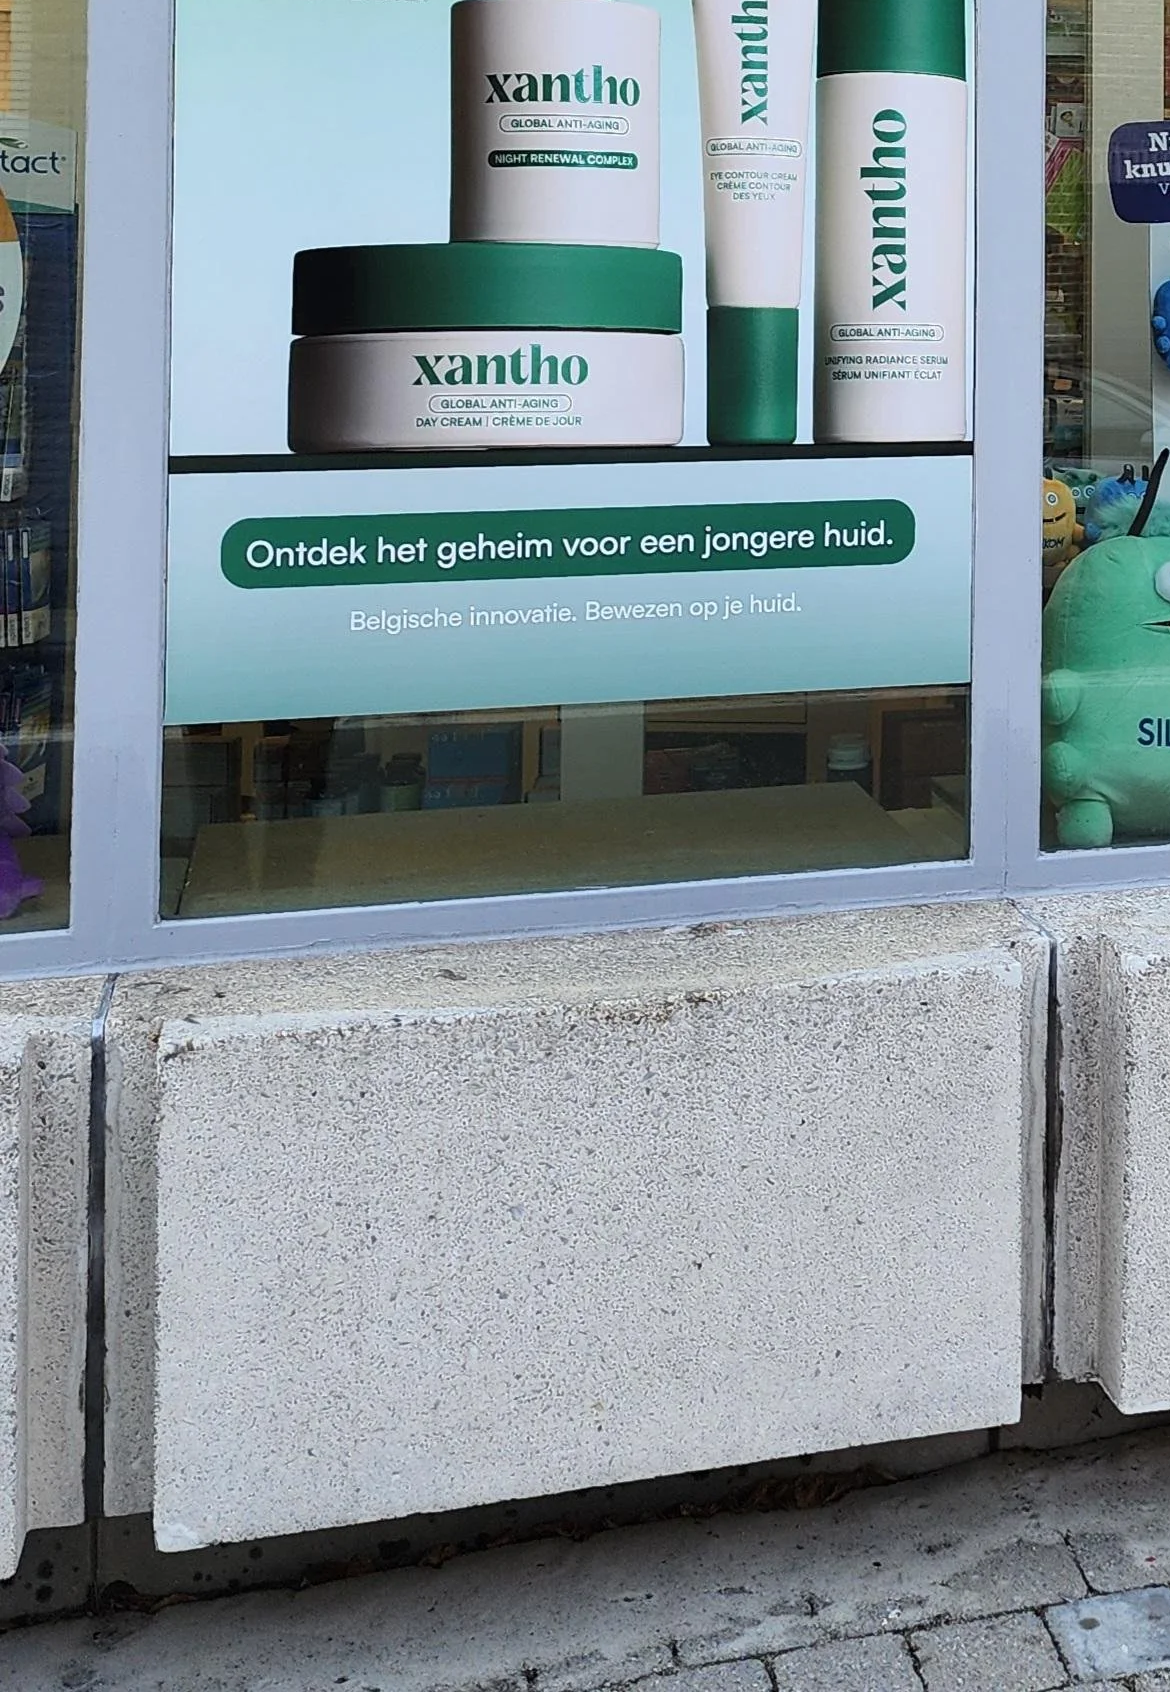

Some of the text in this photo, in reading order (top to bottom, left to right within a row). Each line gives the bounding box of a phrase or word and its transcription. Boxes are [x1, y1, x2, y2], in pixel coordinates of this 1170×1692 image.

[484, 65, 640, 106] xantho
[511, 119, 619, 130] GLOBAL ANTI-AGING
[711, 142, 743, 152] GLOBAL
[495, 153, 633, 166] NIGHT RENEWAL COMPLEX
[725, 171, 769, 181] CONTOUR
[860, 109, 907, 311] xantho
[838, 328, 935, 338] GLOBAL ANTI-AGING
[412, 344, 588, 386] xantho
[865, 355, 918, 365] RADIANCE
[920, 356, 948, 365] SERUM
[864, 370, 912, 380] UNIFIANT
[440, 399, 558, 409] GLOBAL ANTI-AGING
[416, 414, 581, 427] DAY CREAM CRÈME DE JOUR
[246, 520, 893, 568] Ontdek het geheim voor een jongere huid.
[350, 592, 802, 635] Belgische innovatie. Bewezen op je huid.
